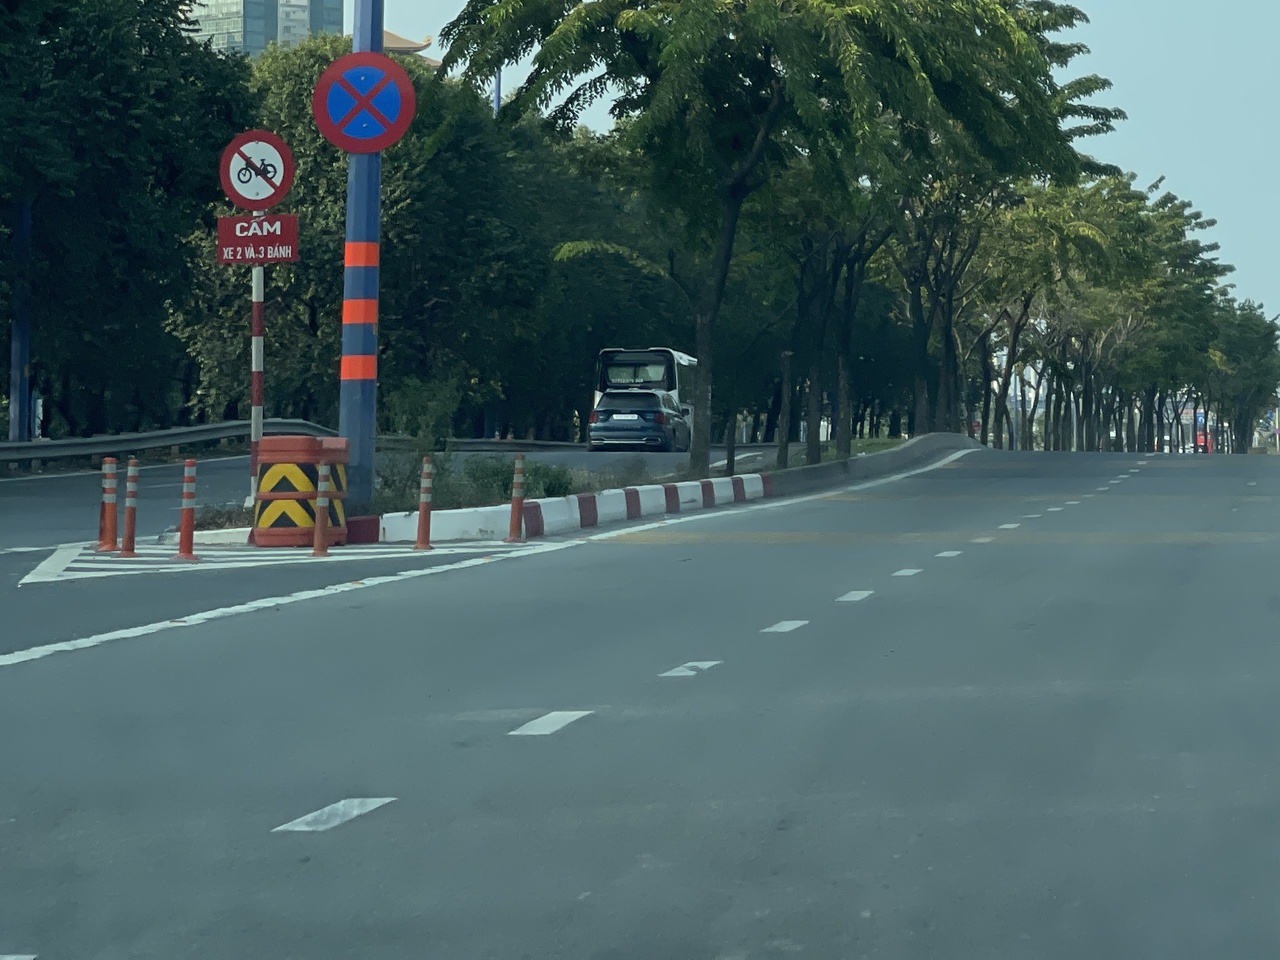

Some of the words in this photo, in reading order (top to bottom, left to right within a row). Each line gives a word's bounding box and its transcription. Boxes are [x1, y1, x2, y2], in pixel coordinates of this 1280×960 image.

[235, 215, 281, 237] CẤM
[222, 247, 235, 260] XE
[236, 247, 243, 260] 2
[244, 243, 256, 259] VÀ
[259, 246, 265, 258] 3
[267, 242, 292, 259] BÁNH
